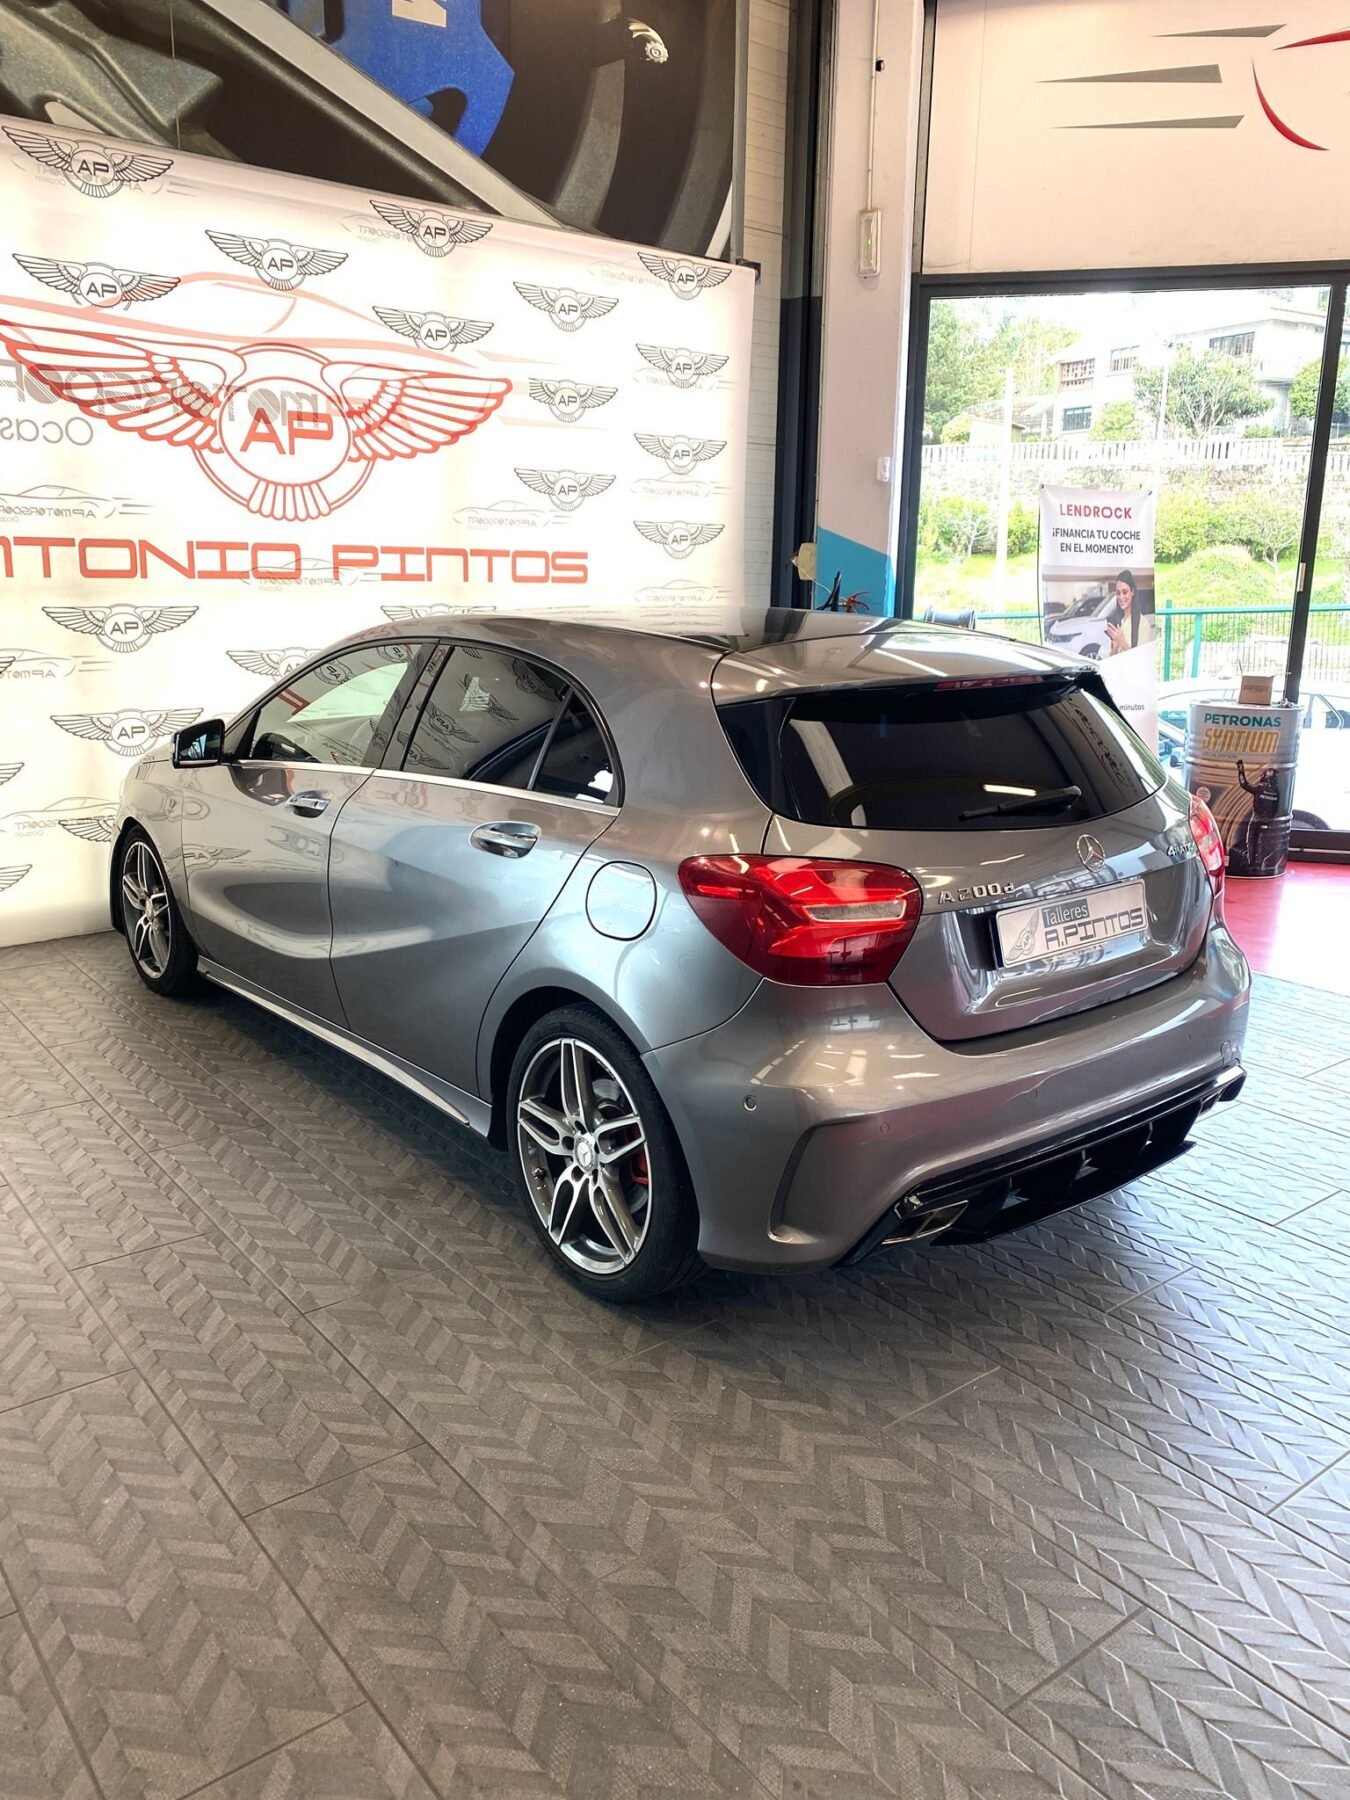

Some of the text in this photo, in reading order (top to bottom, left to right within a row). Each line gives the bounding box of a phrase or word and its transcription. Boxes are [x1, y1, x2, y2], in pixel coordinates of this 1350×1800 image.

[78, 159, 109, 176] AP
[422, 225, 447, 240] AP
[267, 256, 295, 272] AP
[677, 272, 695, 285] AP
[86, 281, 118, 298] AP
[558, 303, 579, 316] AP
[424, 328, 448, 342] AP
[674, 362, 692, 374] AP
[558, 394, 578, 408] AP
[239, 407, 333, 456] AP
[672, 449, 691, 460] AP
[557, 484, 578, 496] AP
[1059, 503, 1132, 519] LENDROCK
[670, 534, 689, 545] AP
[1052, 527, 1141, 541] ¡FINANCIA TU COCHE
[1060, 542, 1134, 554] EN EL MOMENTO!
[0, 535, 589, 584] TONIO PINTOS
[110, 620, 139, 635] AP
[1119, 703, 1145, 711] minutos
[1204, 713, 1282, 728] PETRONAS
[117, 726, 146, 740] AP
[1202, 727, 1281, 753] SYNTIUM
[1043, 904, 1090, 926] Talleres
